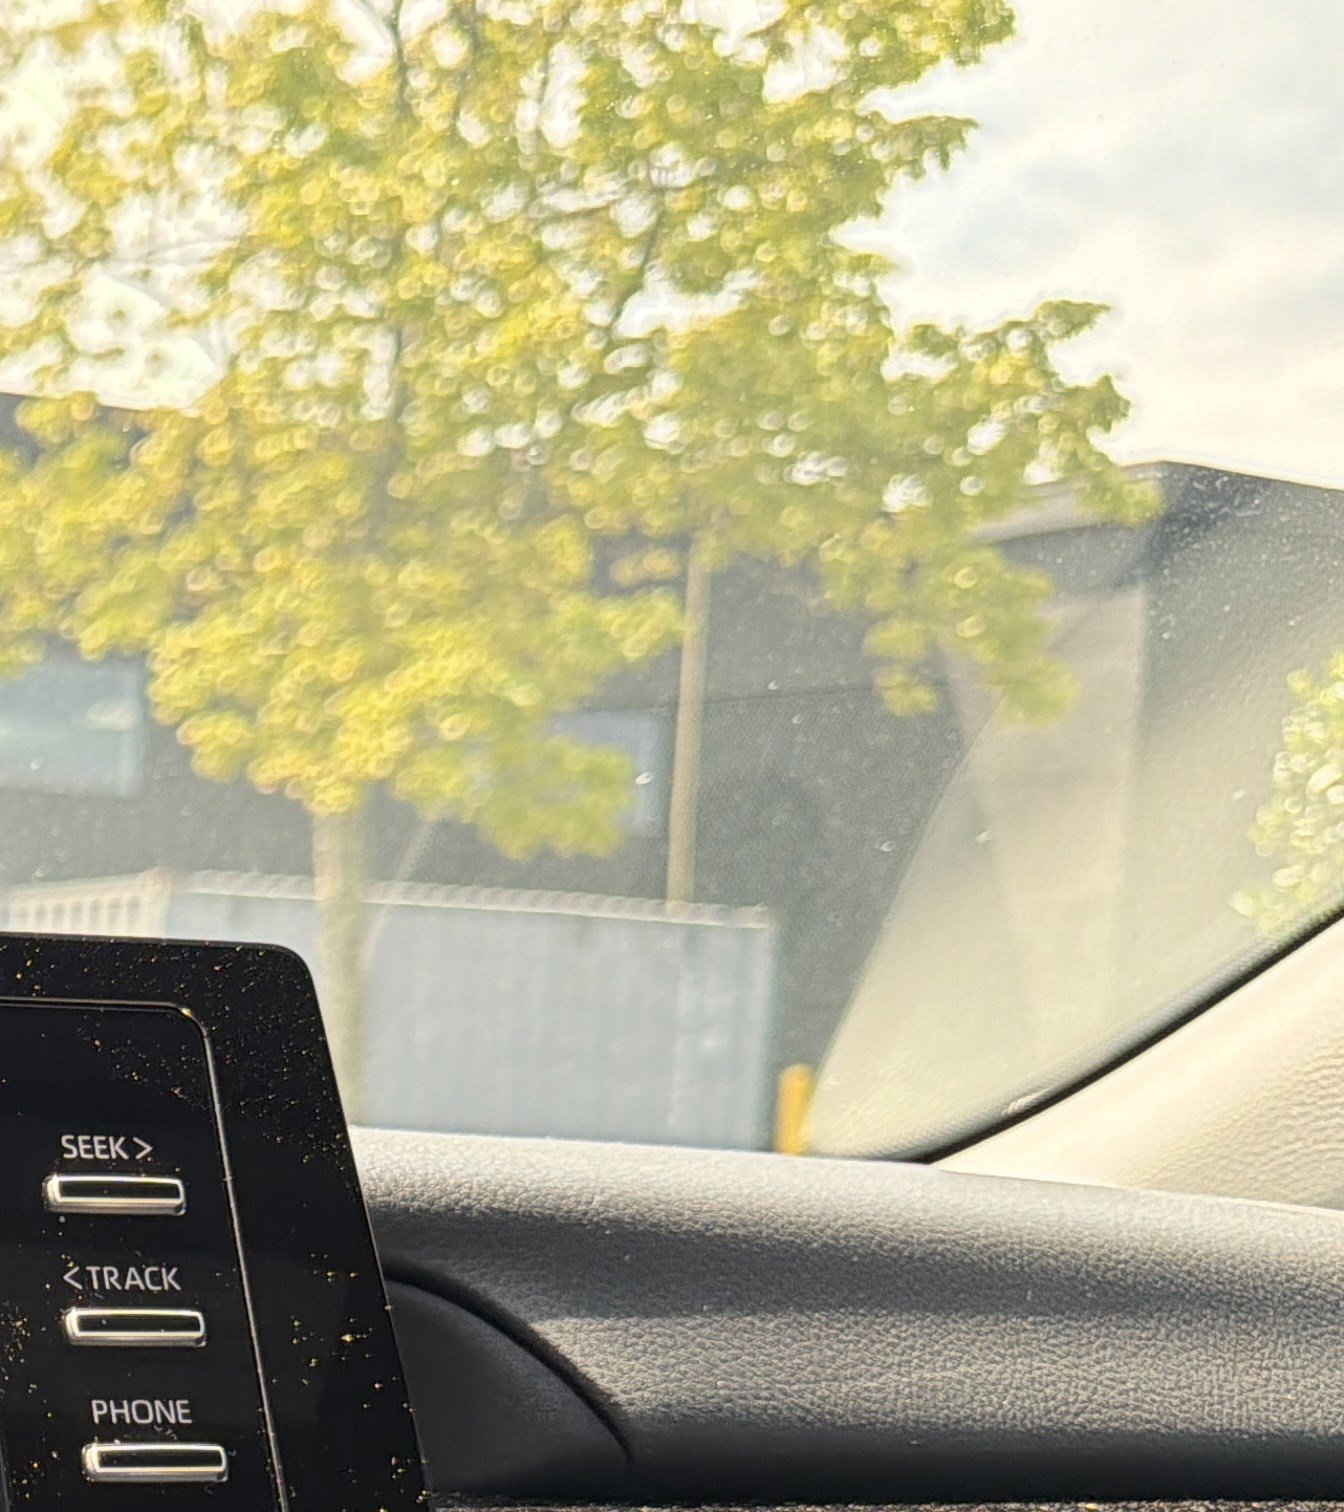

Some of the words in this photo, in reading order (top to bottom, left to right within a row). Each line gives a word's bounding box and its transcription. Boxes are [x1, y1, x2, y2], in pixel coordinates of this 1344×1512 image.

[61, 1134, 128, 1160] SEEK
[86, 1266, 181, 1292] TRACK
[91, 1400, 193, 1425] PHONE
